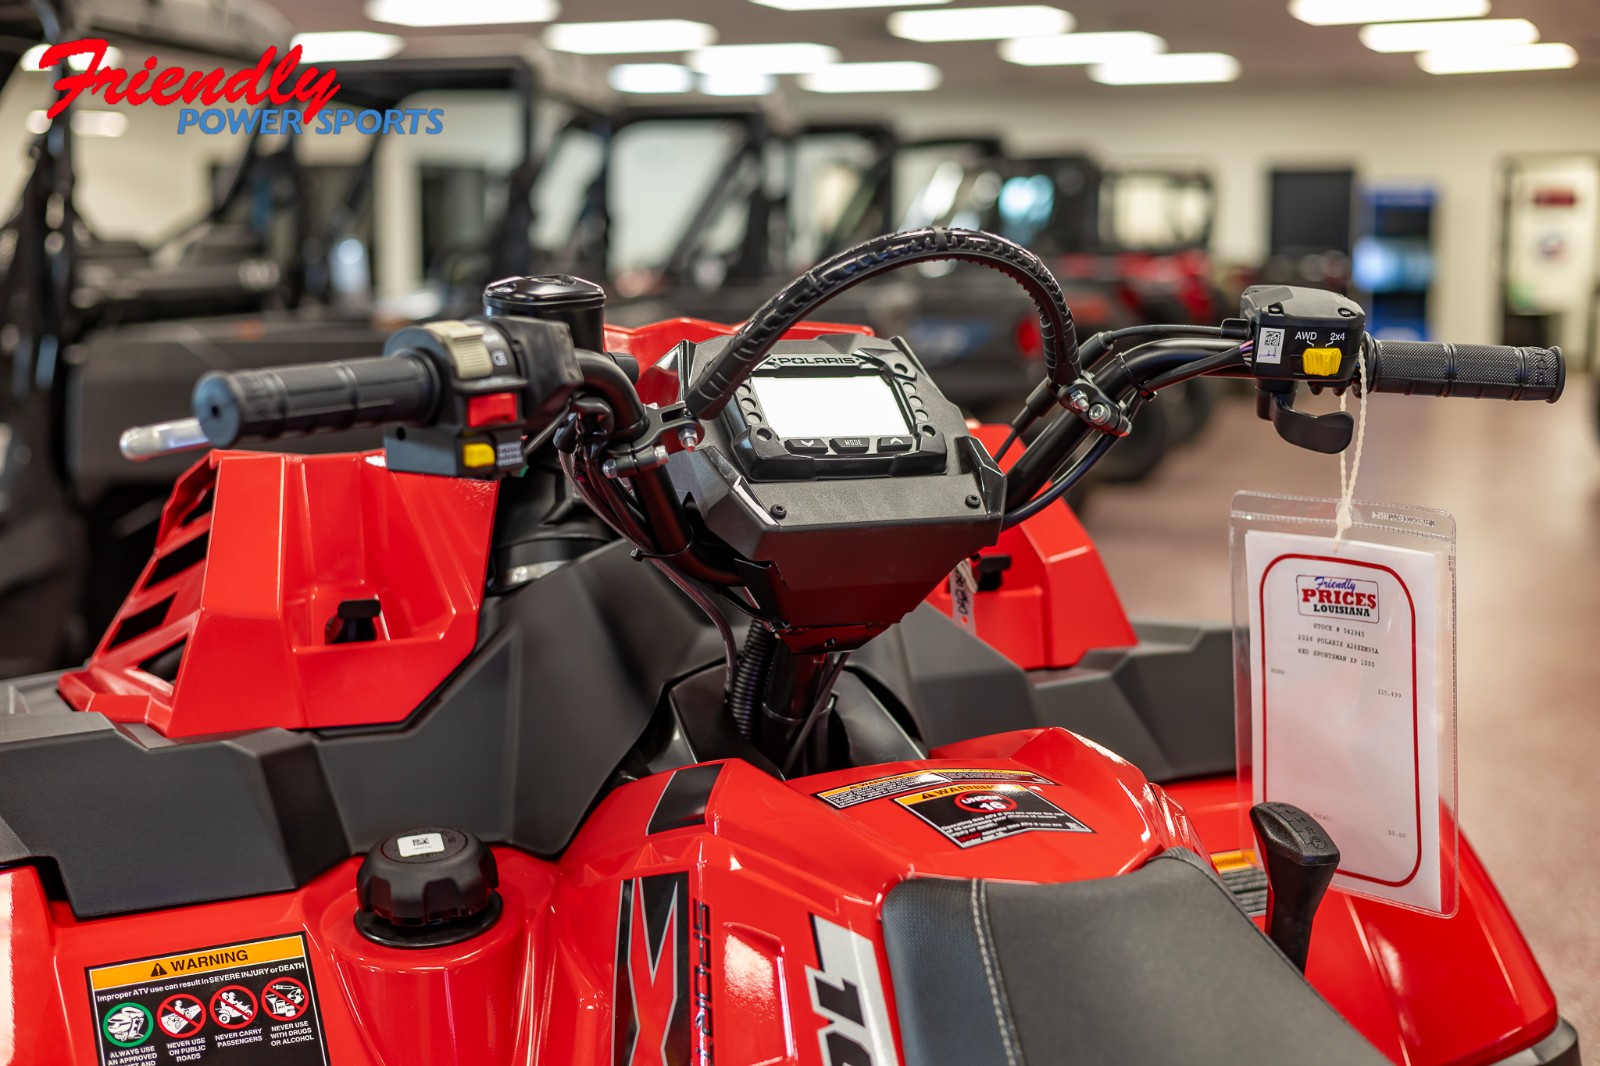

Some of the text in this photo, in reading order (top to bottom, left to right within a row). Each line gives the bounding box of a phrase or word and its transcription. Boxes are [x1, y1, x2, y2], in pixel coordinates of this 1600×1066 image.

[1294, 332, 1346, 341] AWD 2x4
[777, 356, 856, 364] POLARIS
[1313, 576, 1356, 592] Friendly
[1302, 588, 1377, 610] PRICES
[1313, 604, 1370, 617] LOUISIANA
[1313, 623, 1332, 631] STOCK
[1317, 638, 1343, 647] POLARIS
[1313, 650, 1347, 662] SPORTSMAN
[961, 795, 1002, 804] UNDER
[980, 802, 1006, 810] 16
[170, 950, 249, 972] WARNING
[97, 990, 132, 1002] Improper
[132, 987, 149, 996] ATV
[179, 979, 201, 988] result
[209, 973, 241, 984] SEVERE
[241, 968, 268, 978] INJURY
[279, 962, 305, 972] DEATH
[271, 1023, 294, 1032] NEVER
[288, 1028, 312, 1036] DRUGS
[214, 1028, 263, 1041] NEVER CARRY
[216, 1035, 263, 1048] PASSENGERS
[282, 1035, 314, 1045] ALCOHOL
[166, 1041, 190, 1050] NEVER
[180, 1045, 206, 1054] PUBLIC
[110, 1049, 140, 1059] ALWAYS
[120, 1052, 158, 1064] APPROVED
[175, 1053, 201, 1063] ROADS
